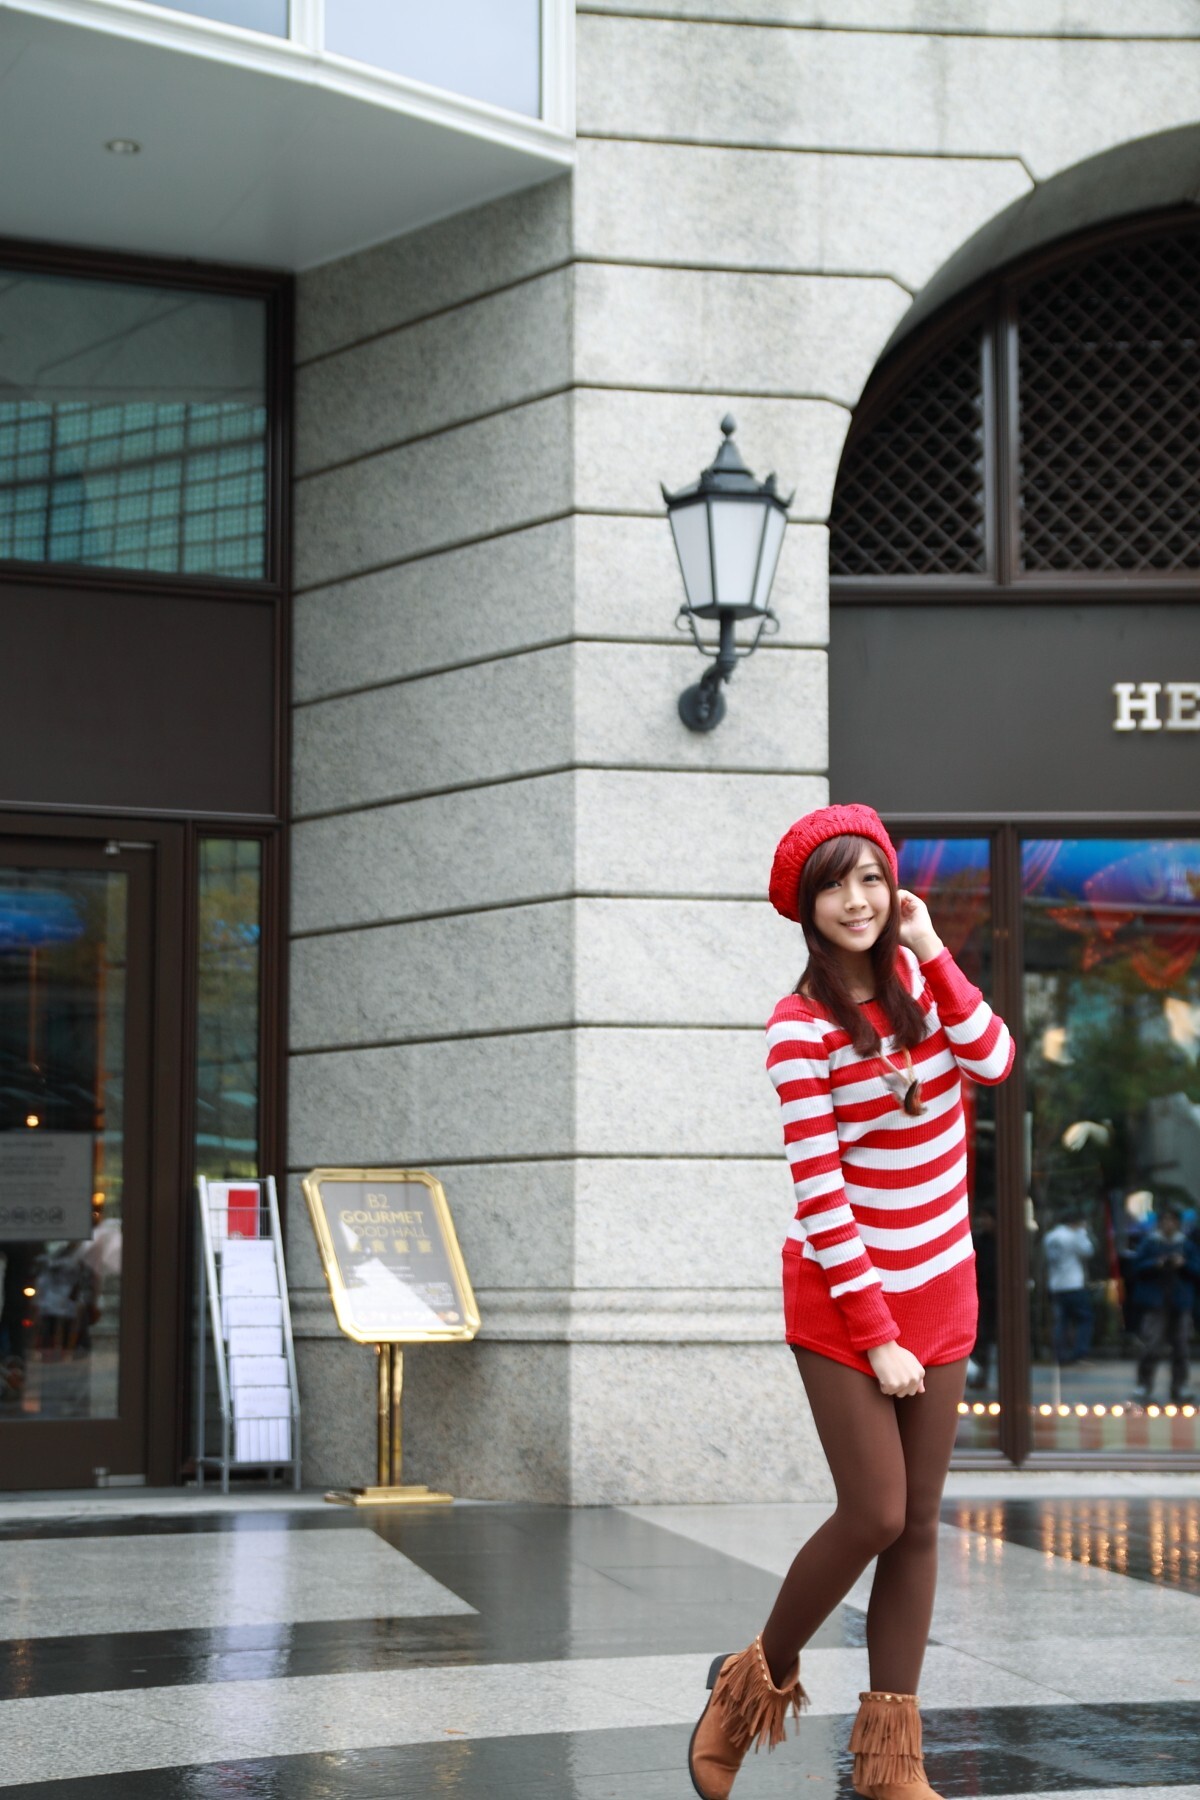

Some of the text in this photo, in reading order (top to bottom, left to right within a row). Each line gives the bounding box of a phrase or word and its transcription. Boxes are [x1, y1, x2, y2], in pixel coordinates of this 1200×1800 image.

[367, 1193, 391, 1209] B2
[341, 1210, 423, 1224] GOURMET
[347, 1225, 428, 1238] OOD HALL
